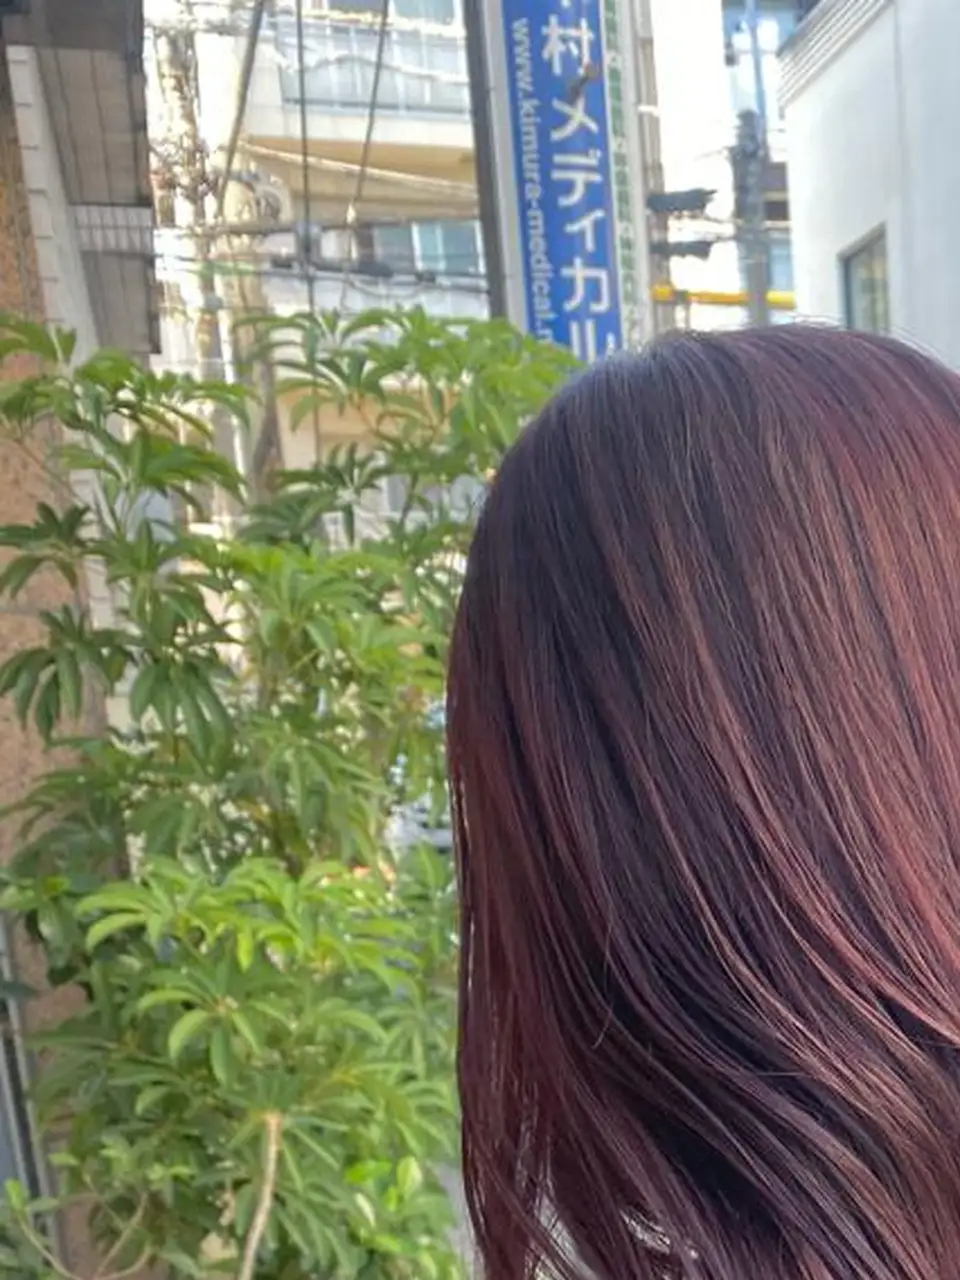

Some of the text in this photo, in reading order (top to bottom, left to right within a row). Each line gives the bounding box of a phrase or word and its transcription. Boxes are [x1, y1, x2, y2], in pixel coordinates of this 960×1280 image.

[541, 0, 616, 364] 村メディカル
